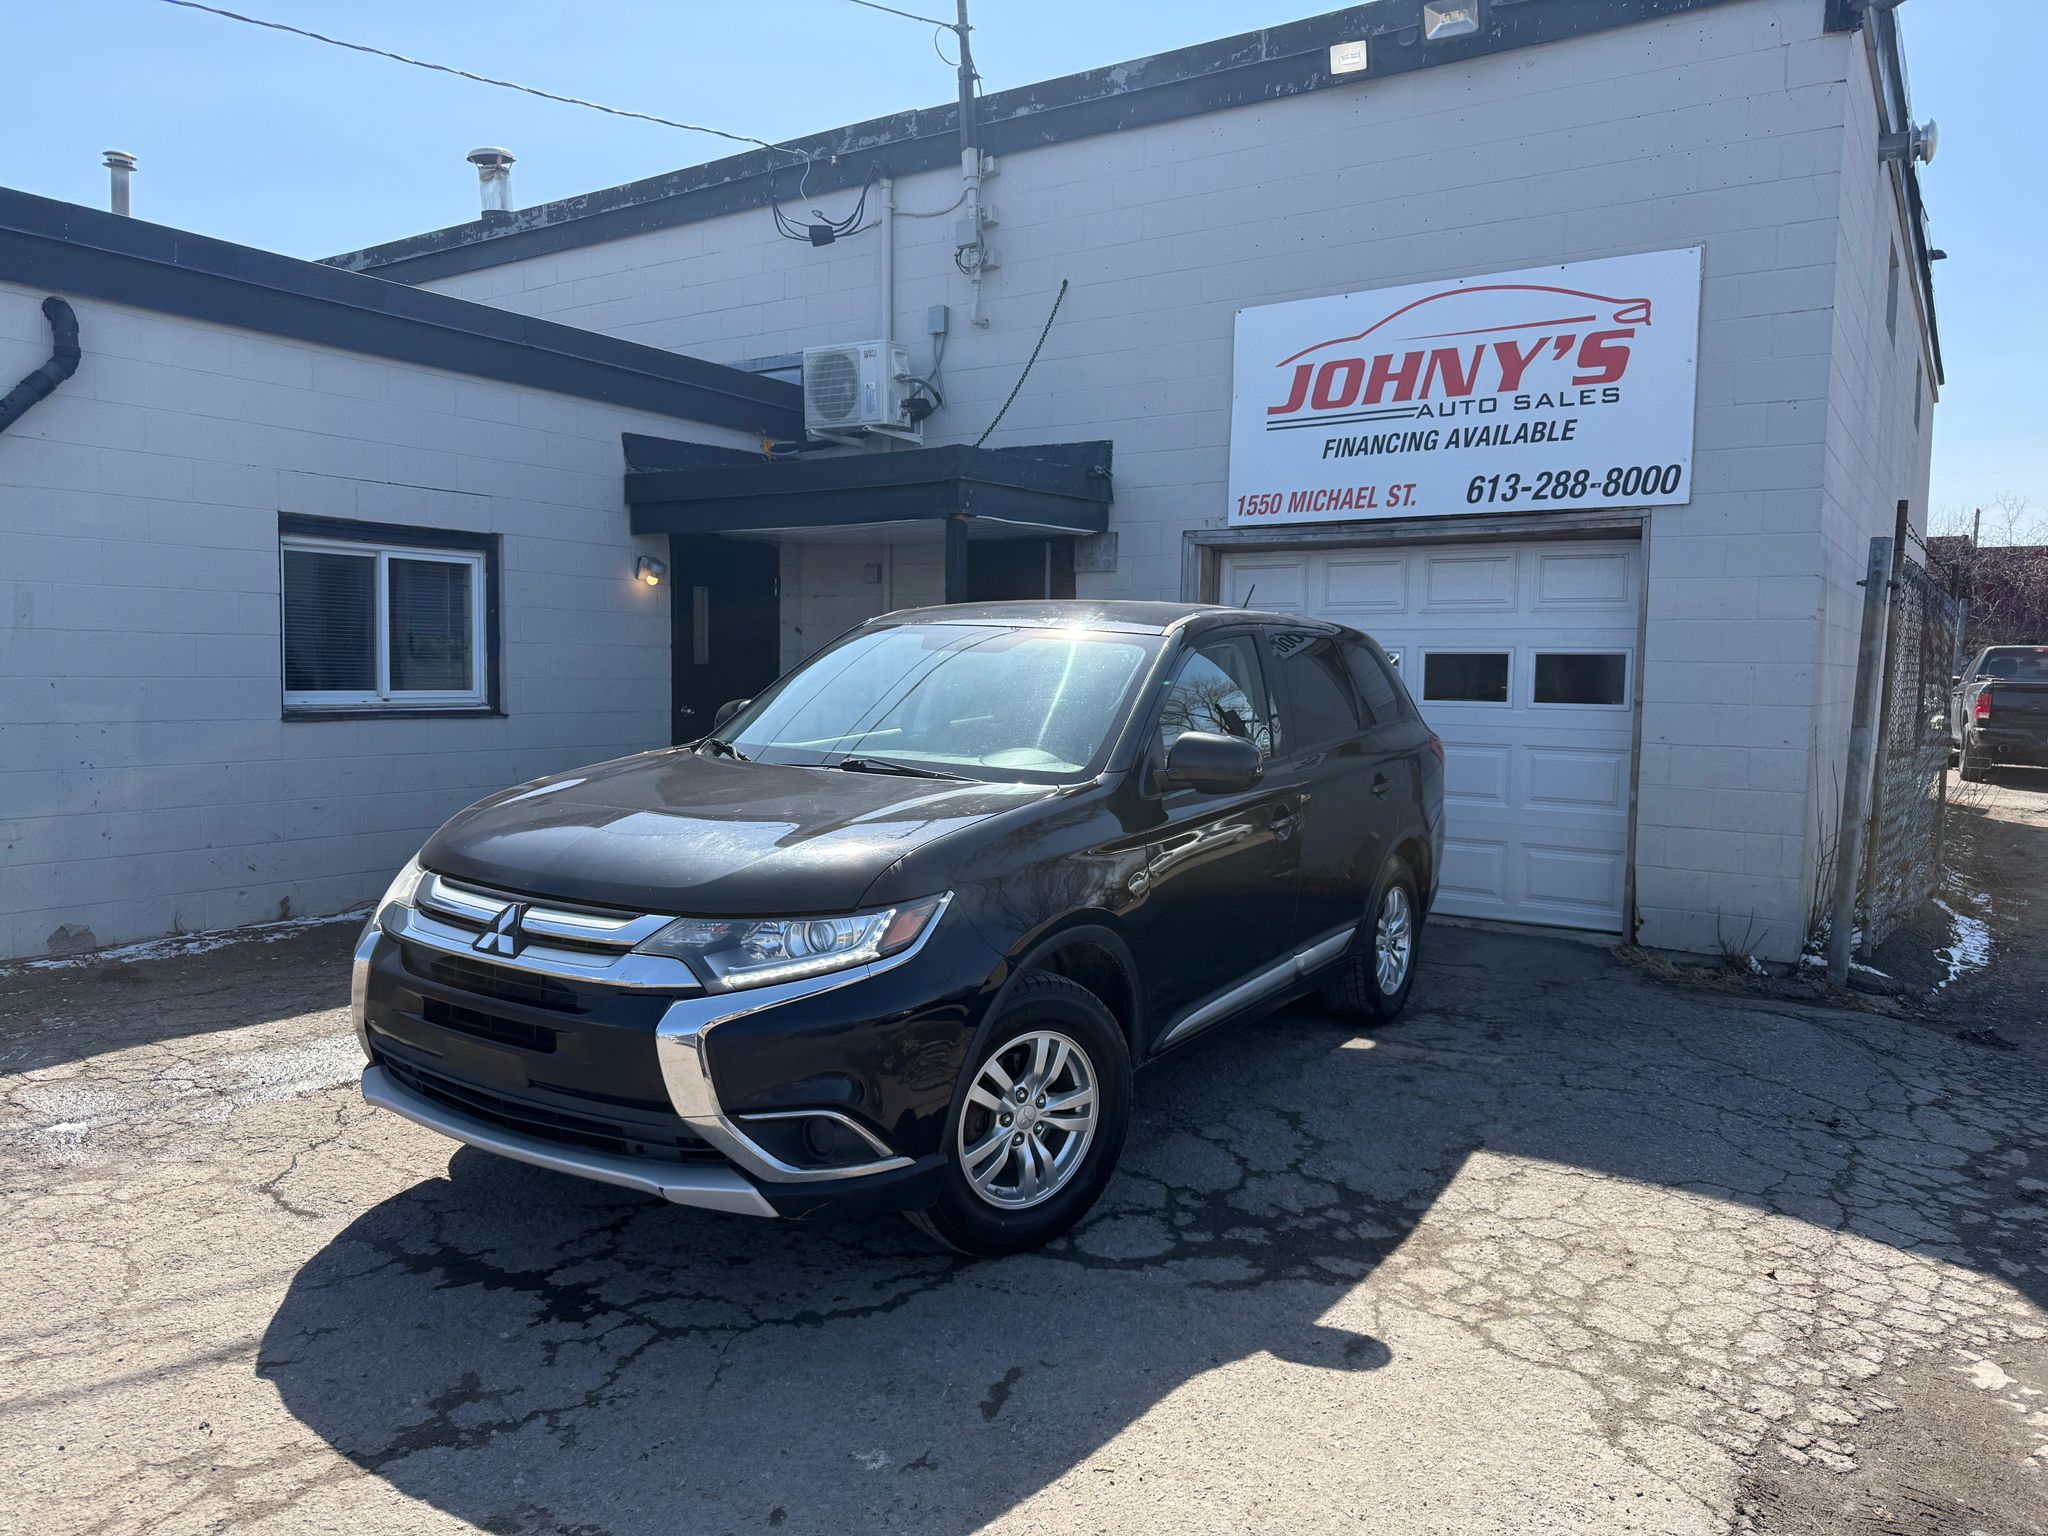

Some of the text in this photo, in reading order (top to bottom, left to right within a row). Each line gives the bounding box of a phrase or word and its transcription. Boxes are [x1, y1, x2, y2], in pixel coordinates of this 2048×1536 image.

[1267, 328, 1635, 415] JOHNY'S
[1416, 386, 1620, 418] AUTO SALES
[1322, 418, 1577, 459] FINANCING AVAILABLE
[1237, 483, 1417, 517] 1550 MICHAEL ST.
[1466, 464, 1682, 505] 613-288-8000
